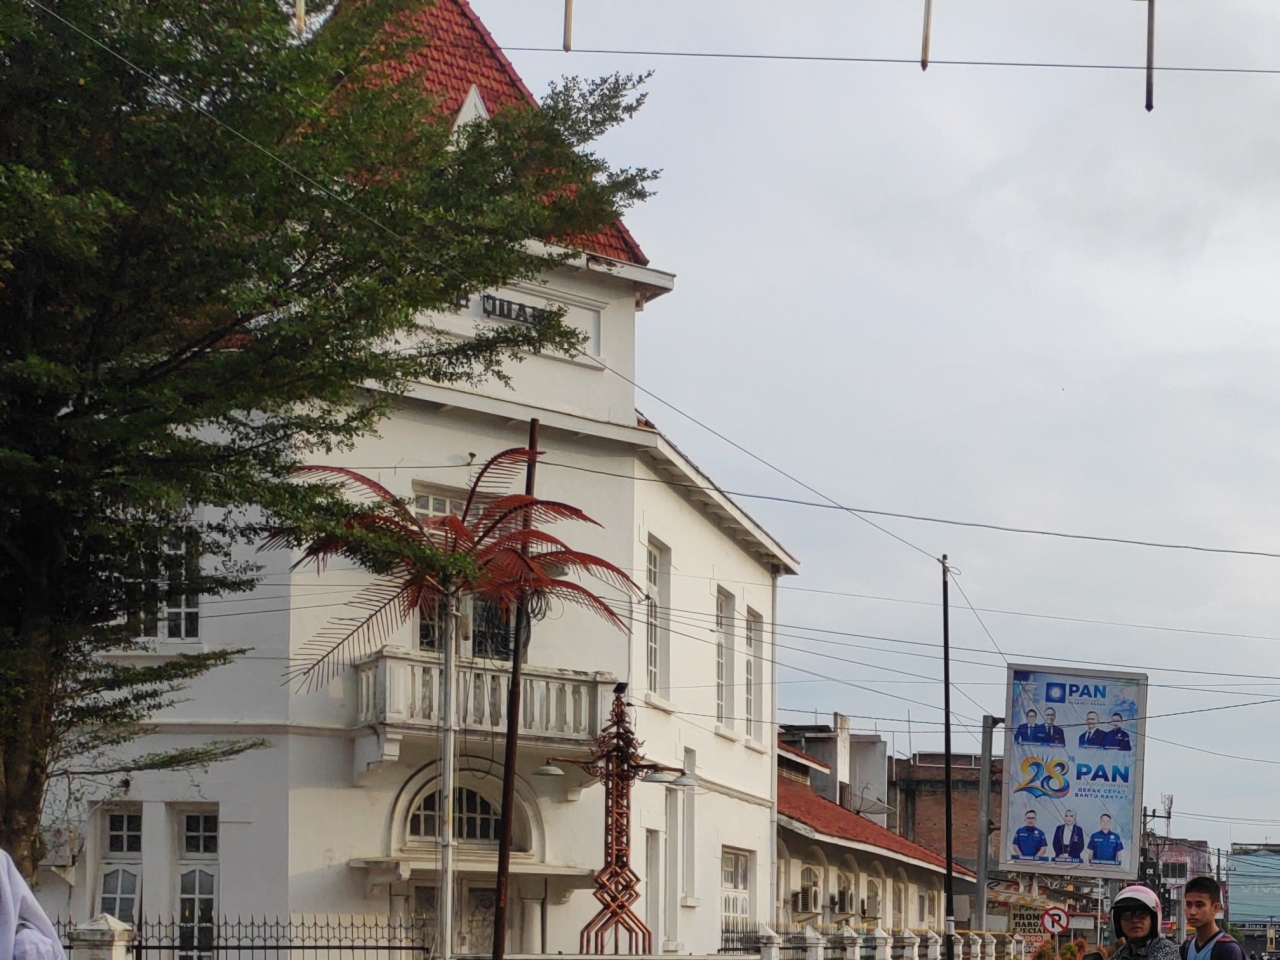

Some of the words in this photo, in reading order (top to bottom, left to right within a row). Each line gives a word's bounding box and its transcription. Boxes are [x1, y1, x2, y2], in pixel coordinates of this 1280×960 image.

[1069, 684, 1107, 699] PAN
[1013, 756, 1070, 798] 28
[1076, 763, 1130, 783] PAN
[1013, 913, 1042, 921] PROM
